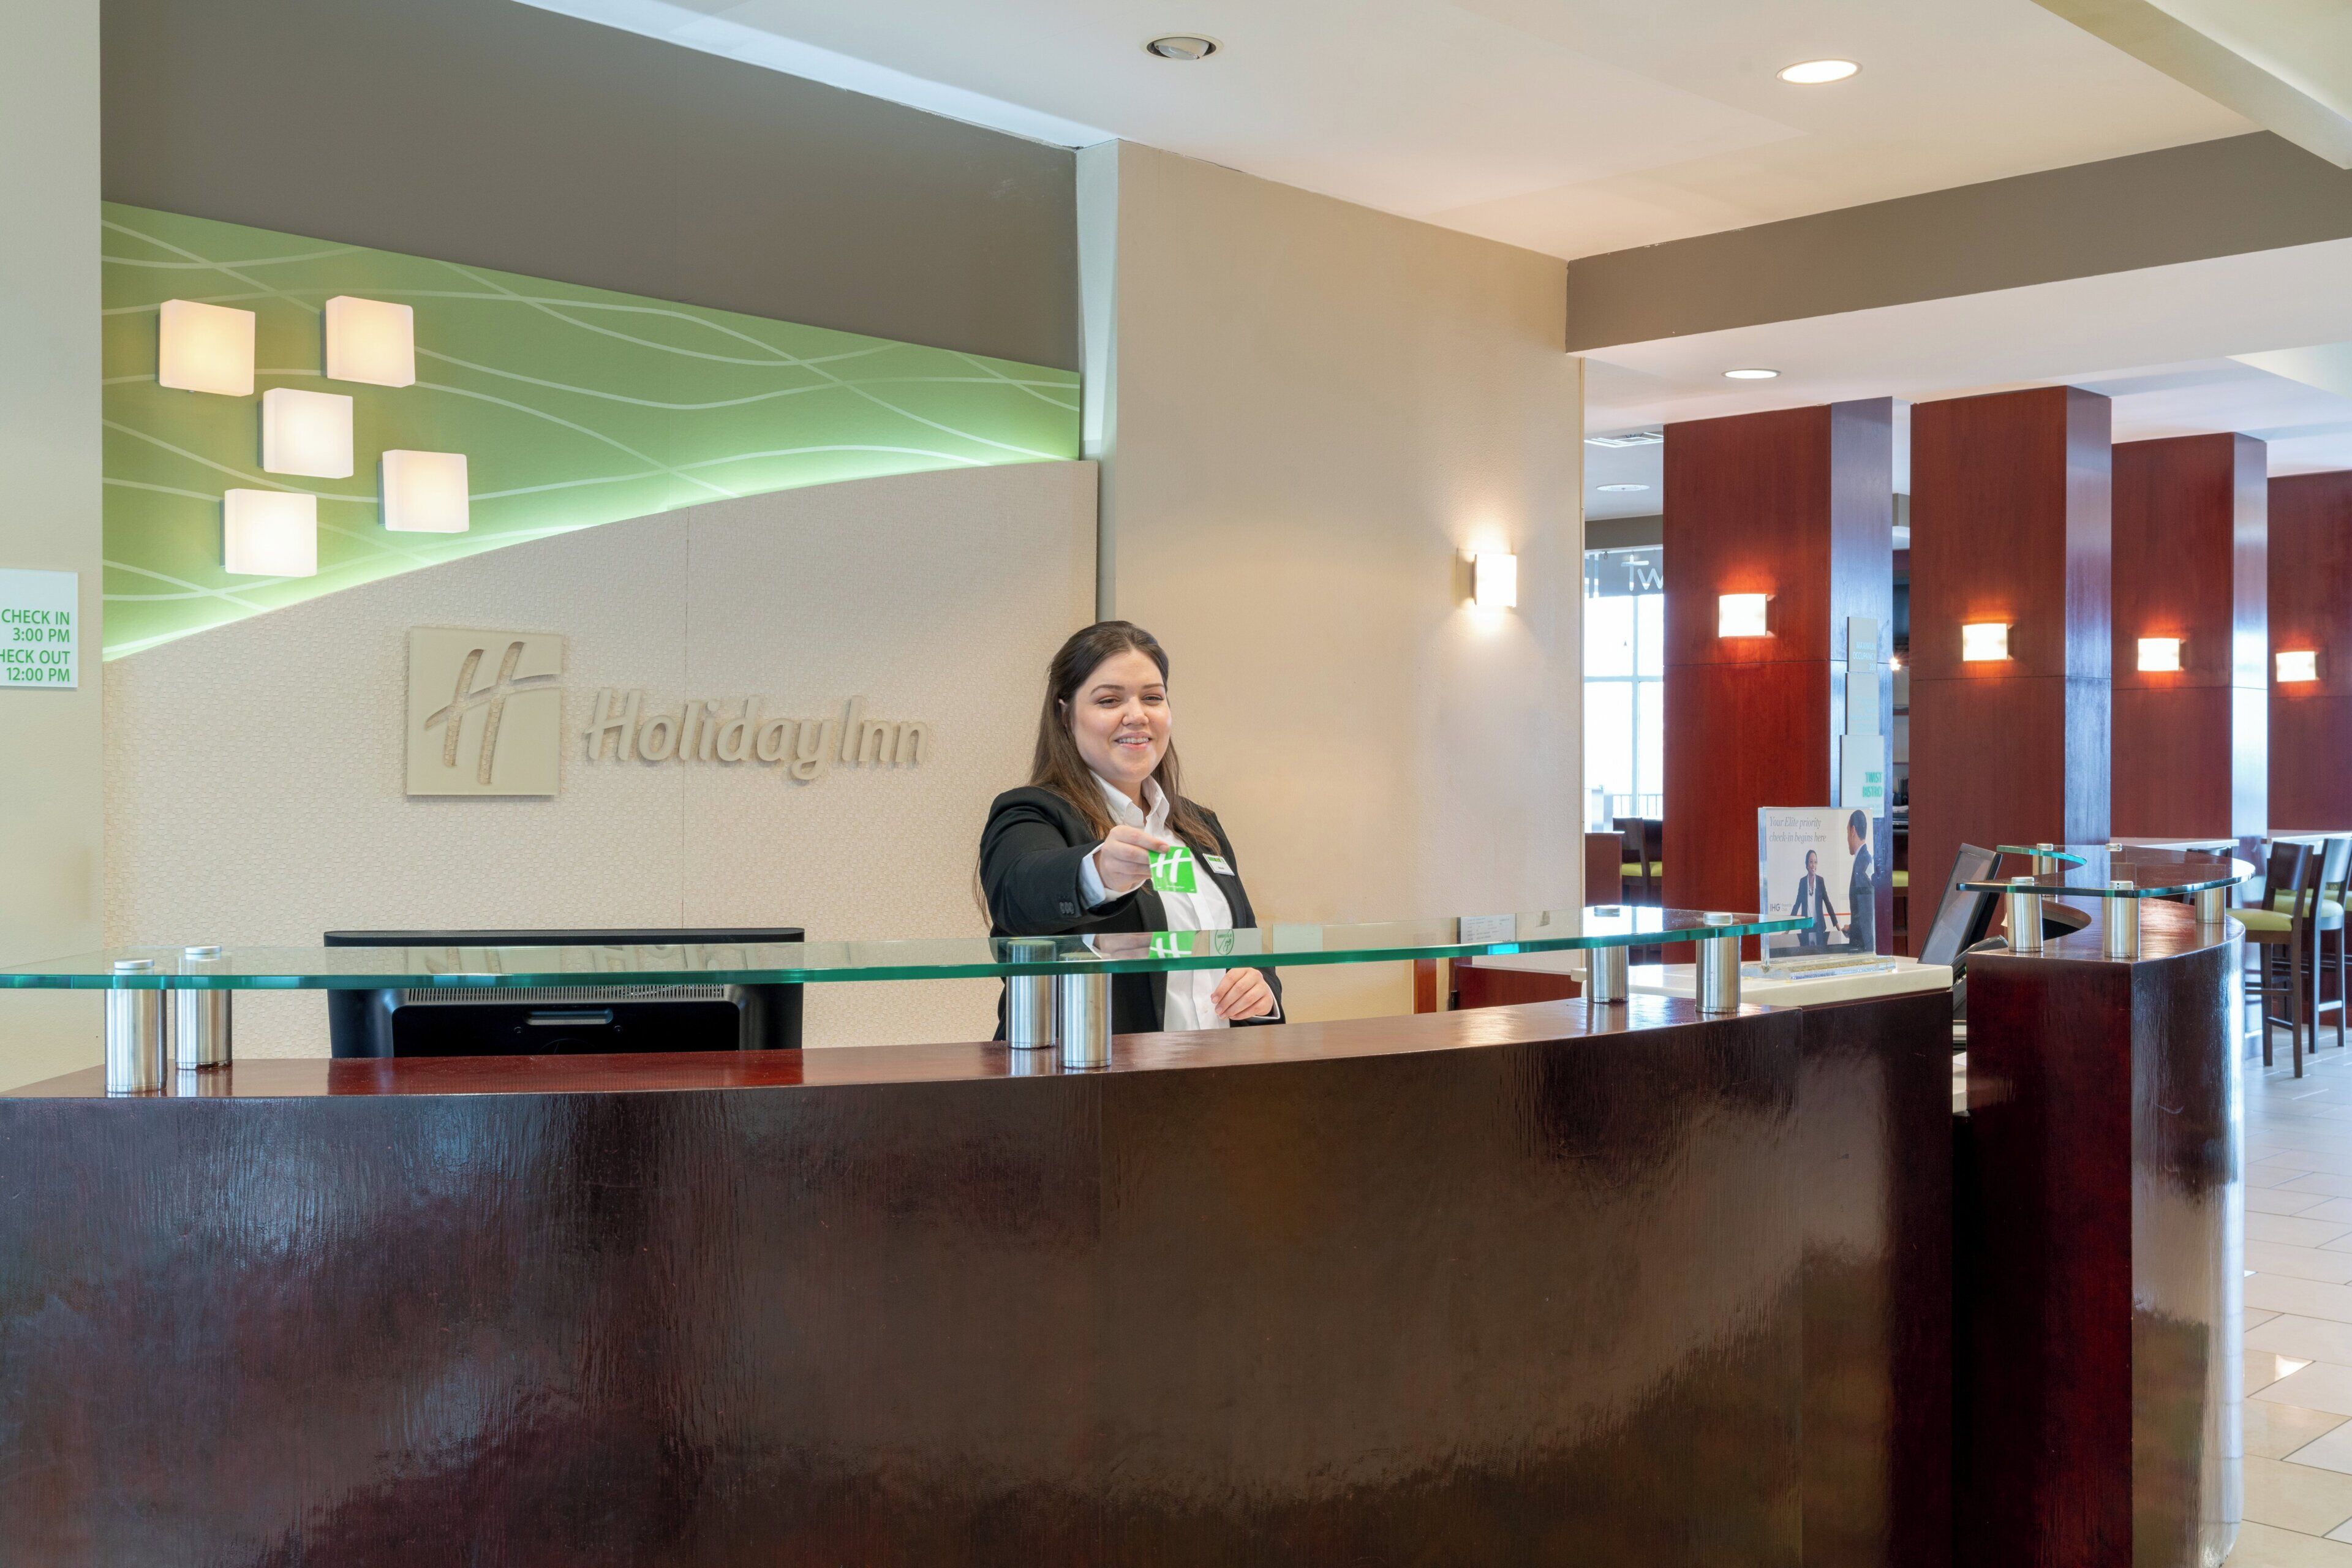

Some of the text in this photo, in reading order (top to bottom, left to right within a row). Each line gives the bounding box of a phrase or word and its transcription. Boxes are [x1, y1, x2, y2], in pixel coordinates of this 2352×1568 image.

[1, 609, 70, 625] CHECK IN
[12, 627, 70, 643] 3:00 PM
[39, 650, 70, 665] OUT
[6, 667, 70, 682] 12:00 PM
[583, 686, 929, 780] Holiday Inn
[1865, 772, 1883, 783] TWIST
[1770, 816, 1822, 829] Your Elite priority
[1769, 831, 1827, 844] check-in begins here
[1770, 903, 1781, 912] IHG
